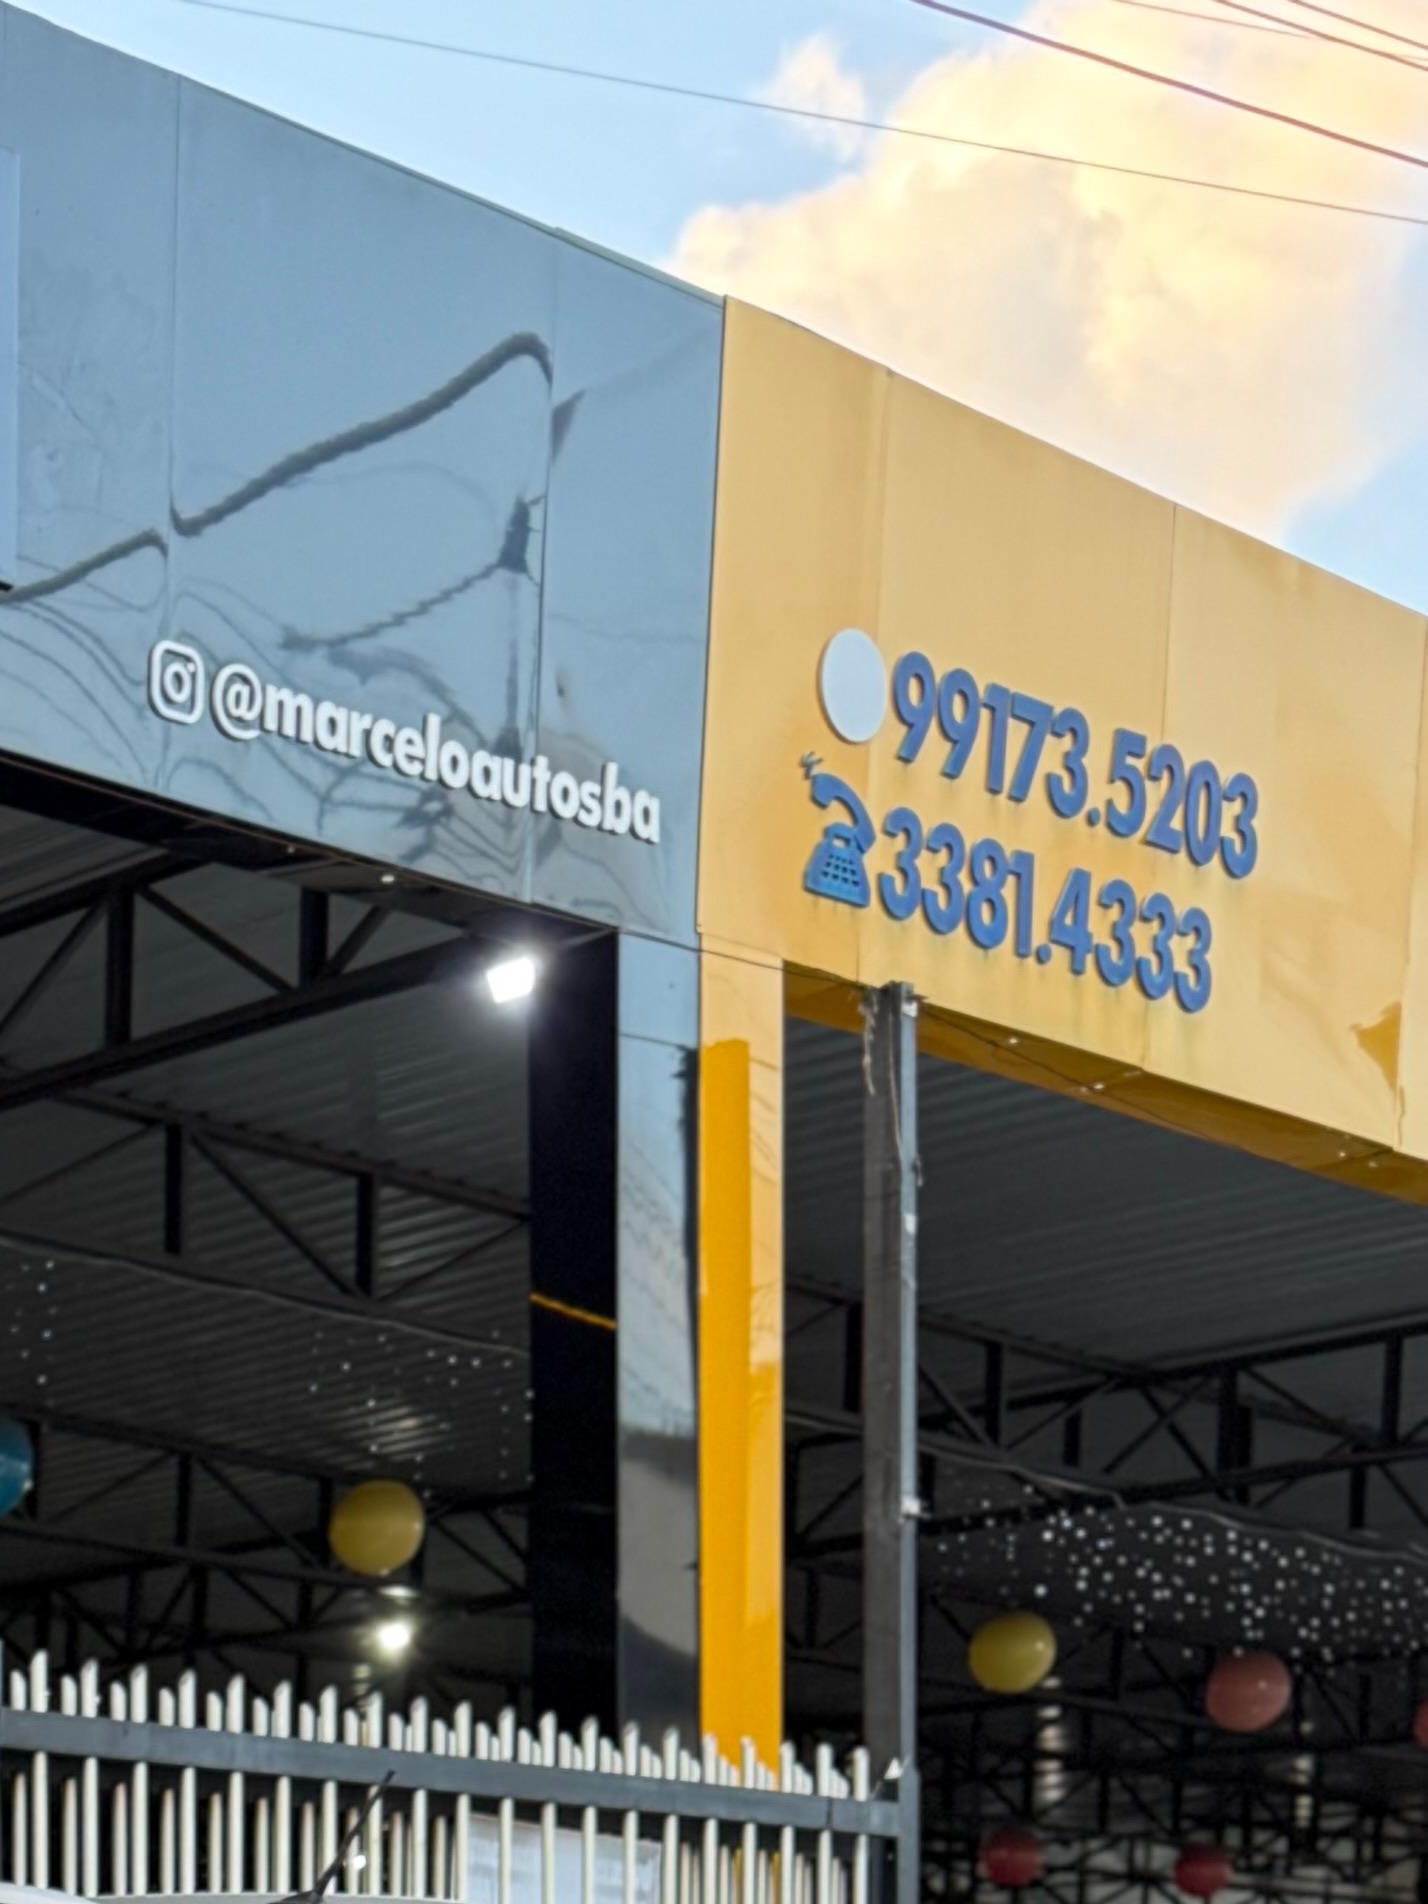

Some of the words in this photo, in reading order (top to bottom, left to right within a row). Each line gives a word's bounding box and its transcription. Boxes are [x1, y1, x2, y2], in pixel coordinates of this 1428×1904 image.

[211, 662, 661, 844] @marceloautosba
[891, 650, 1260, 878] 99173.5203
[876, 807, 1214, 1013] 3381.4333
